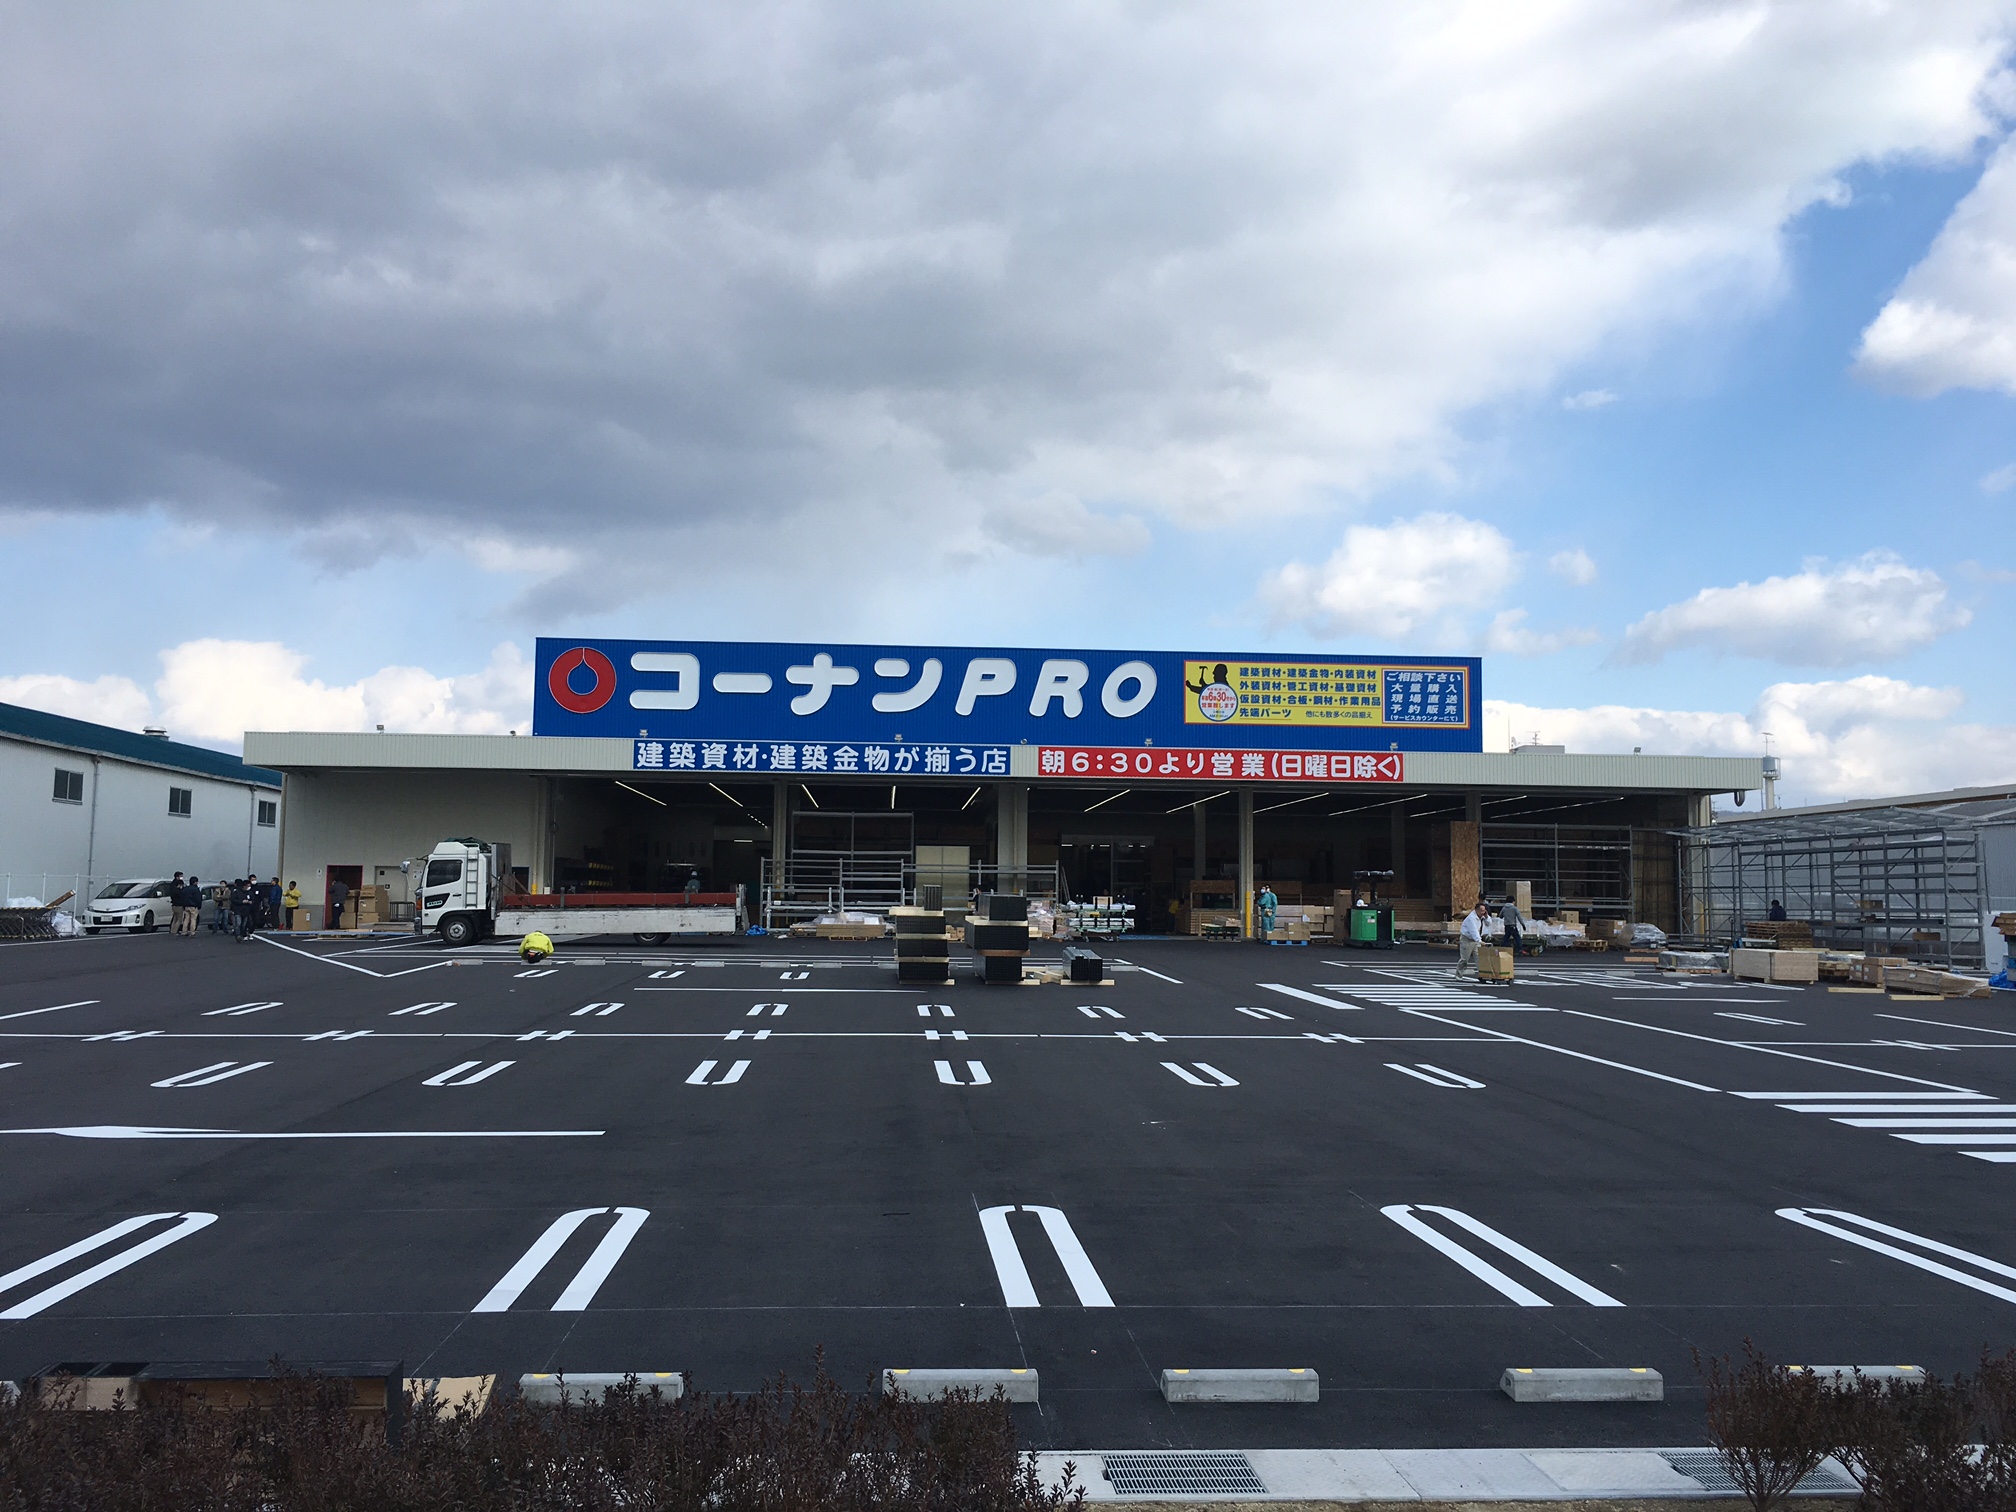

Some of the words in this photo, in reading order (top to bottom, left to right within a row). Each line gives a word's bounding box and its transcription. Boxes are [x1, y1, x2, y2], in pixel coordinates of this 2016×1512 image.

[1239, 667, 1377, 679] 建築資材・建築金物・内装資材
[1386, 672, 1462, 683] ご相談下さい
[1390, 683, 1458, 693] 大量購入
[1239, 694, 1381, 706] 仮設資材・合板・鋼材・作業用品
[1390, 693, 1458, 704] 現場直送
[1239, 708, 1292, 718] 先端パーツ
[1305, 710, 1373, 719] 他にも数多くの品揃え
[1390, 704, 1457, 715] 予約販売
[637, 742, 1008, 775] 建築資材・建築金物が揃う店
